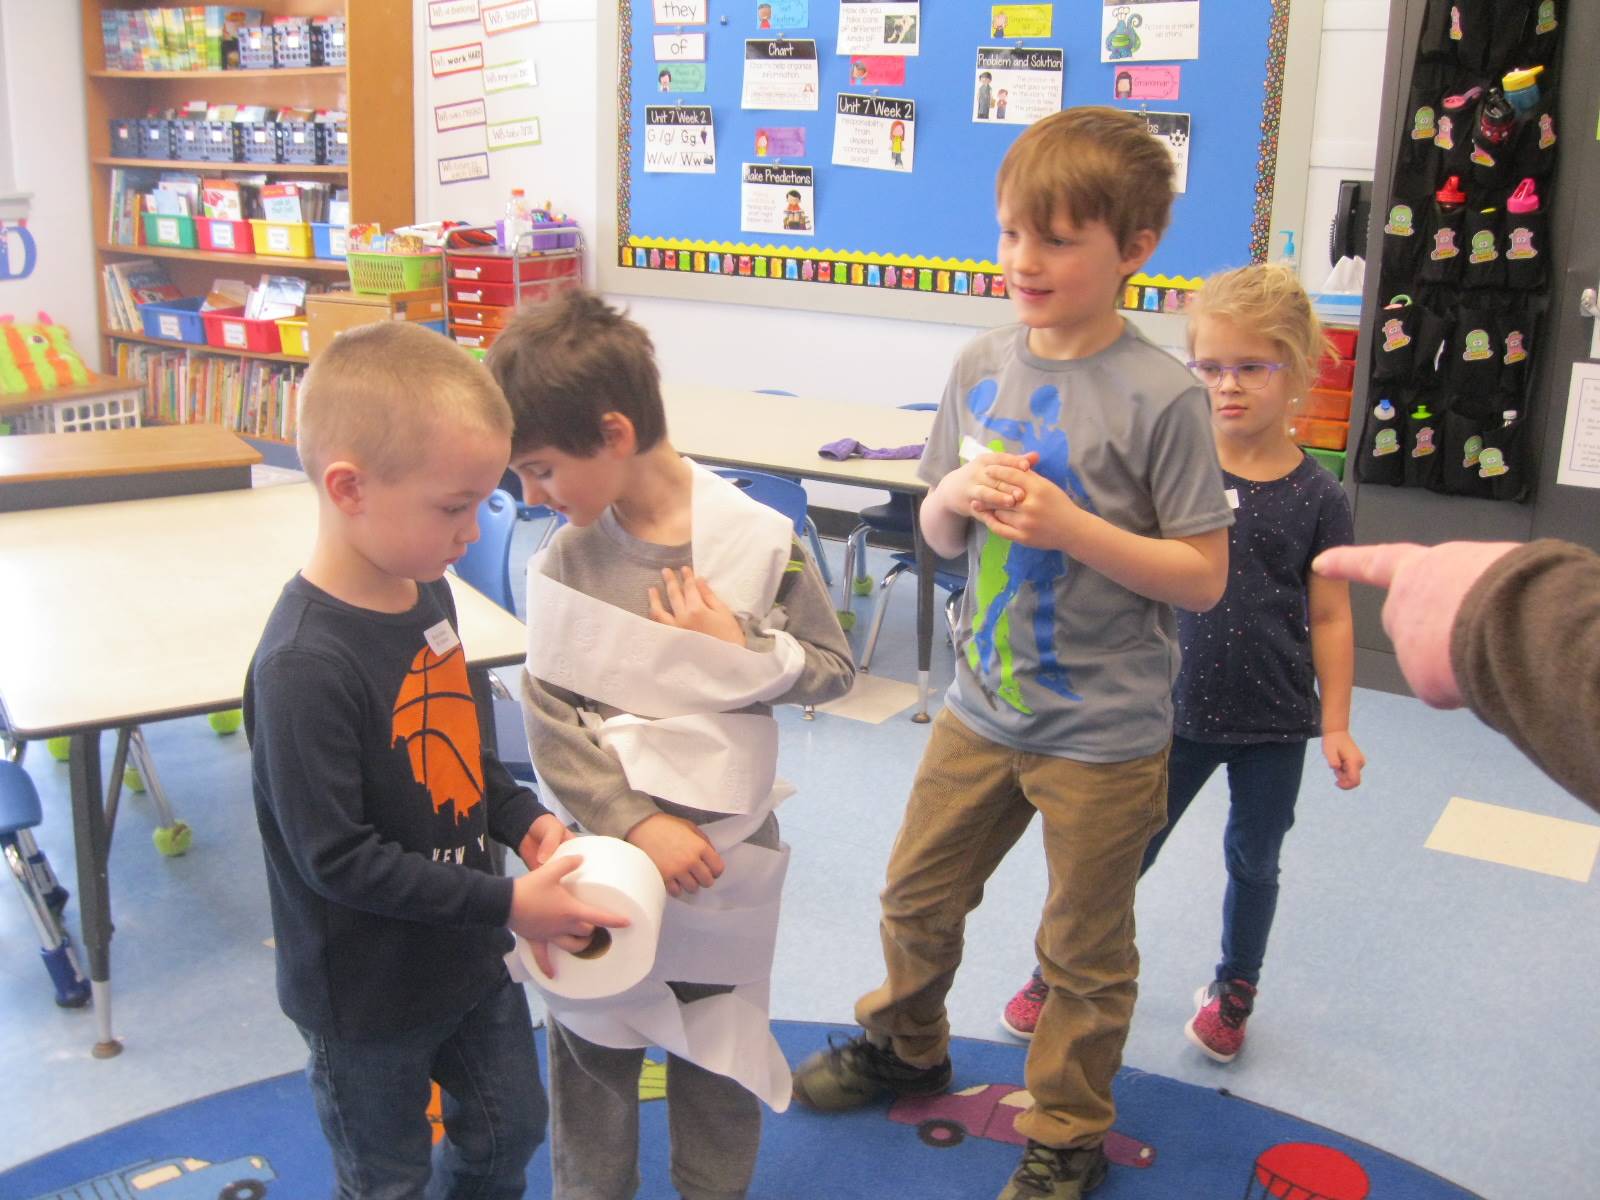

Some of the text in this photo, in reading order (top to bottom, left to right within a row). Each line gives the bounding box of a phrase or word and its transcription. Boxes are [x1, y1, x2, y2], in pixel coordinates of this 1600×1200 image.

[663, 1, 697, 21] they
[670, 38, 689, 55] of
[768, 42, 795, 57] Chart
[447, 55, 466, 65] work
[977, 53, 1062, 68] Problem and Solution
[839, 96, 912, 118] Unit 7 Week 2
[651, 110, 707, 124] Unit 7 Week 2
[647, 128, 656, 142] G
[680, 129, 696, 147] Gg
[680, 151, 702, 166] Ww
[765, 168, 811, 185] Predictions
